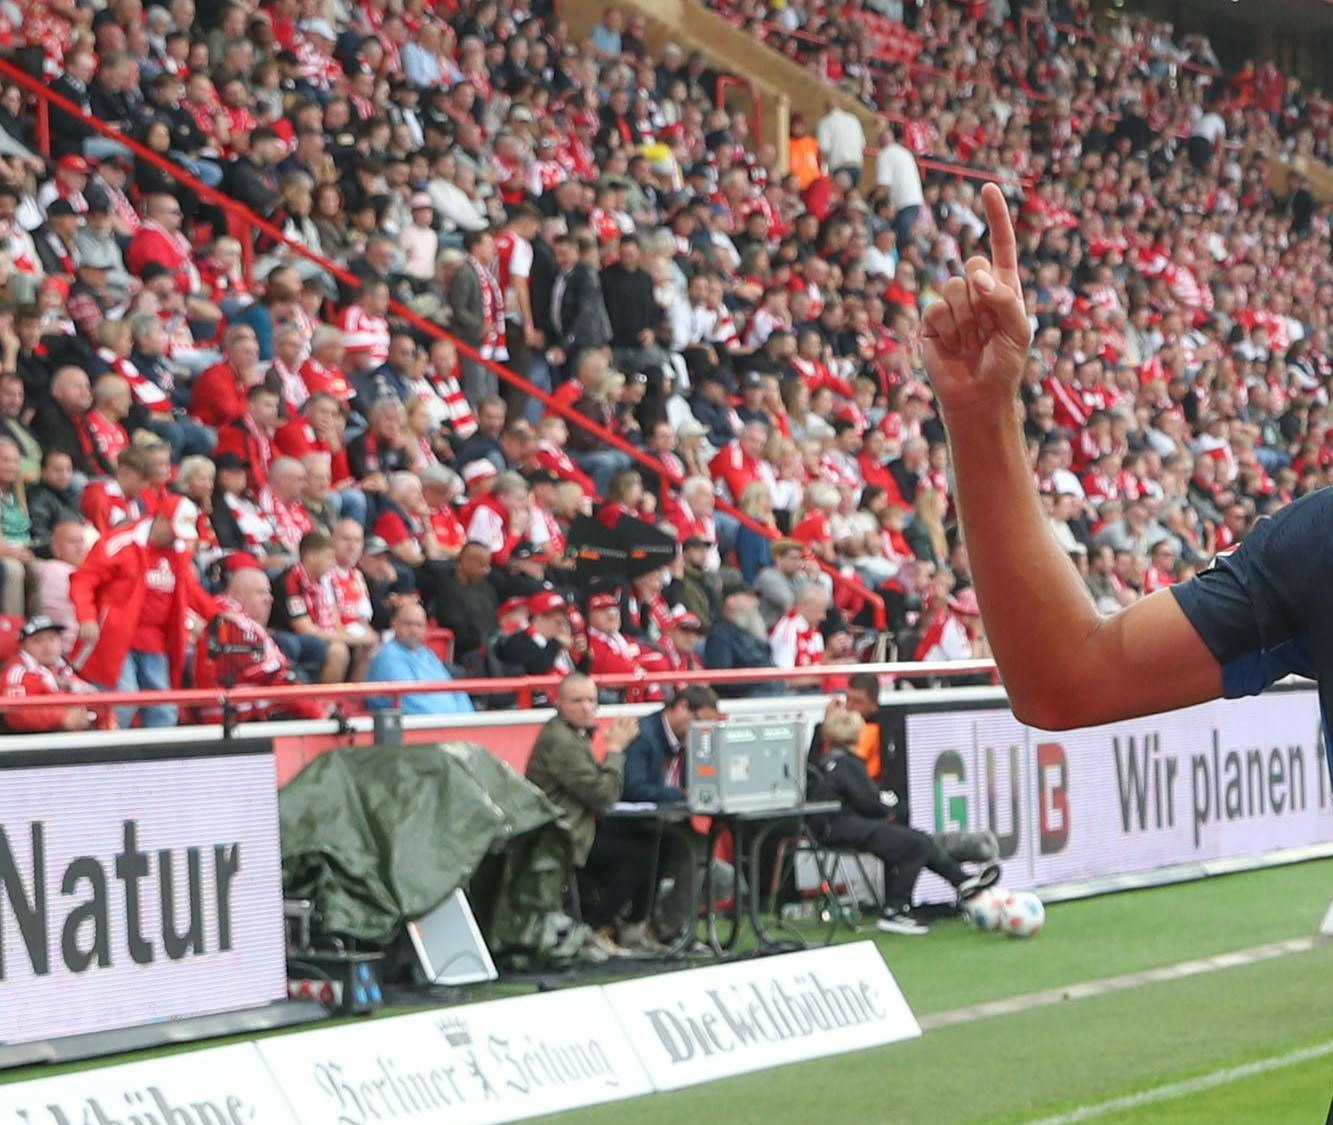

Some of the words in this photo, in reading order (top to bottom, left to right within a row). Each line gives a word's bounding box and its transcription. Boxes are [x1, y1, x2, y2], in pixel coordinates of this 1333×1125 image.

[1113, 732, 1178, 834] Wir
[1191, 728, 1307, 849] planen
[0, 820, 240, 980] Natur
[645, 1001, 735, 1064] Die
